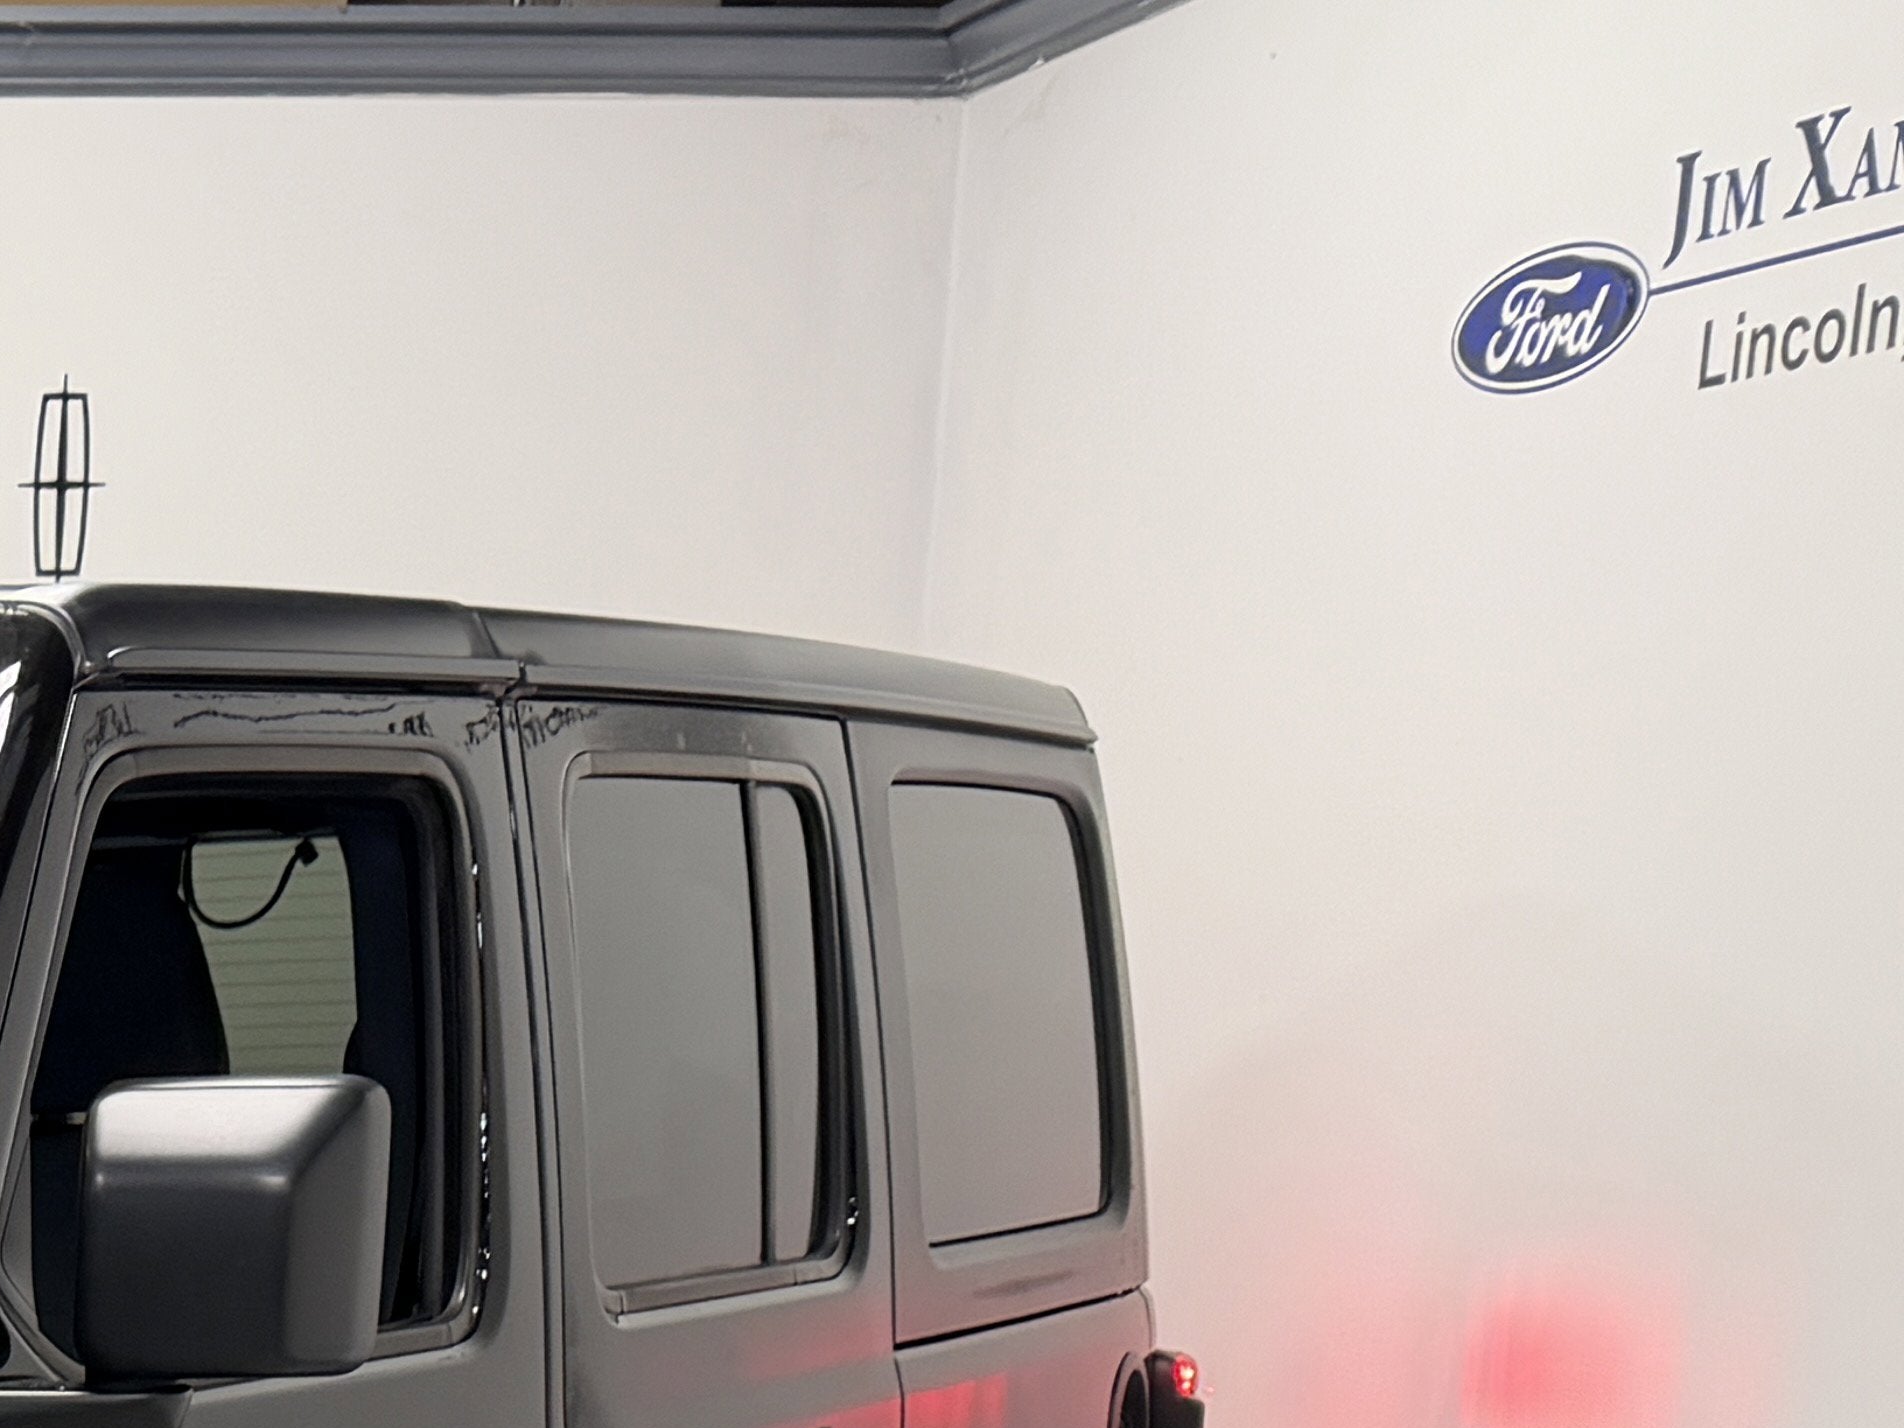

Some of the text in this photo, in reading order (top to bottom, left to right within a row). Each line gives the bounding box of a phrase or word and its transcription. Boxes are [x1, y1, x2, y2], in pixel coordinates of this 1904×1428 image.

[1663, 105, 1904, 270] JIM XA
[1485, 271, 1612, 375] Ford
